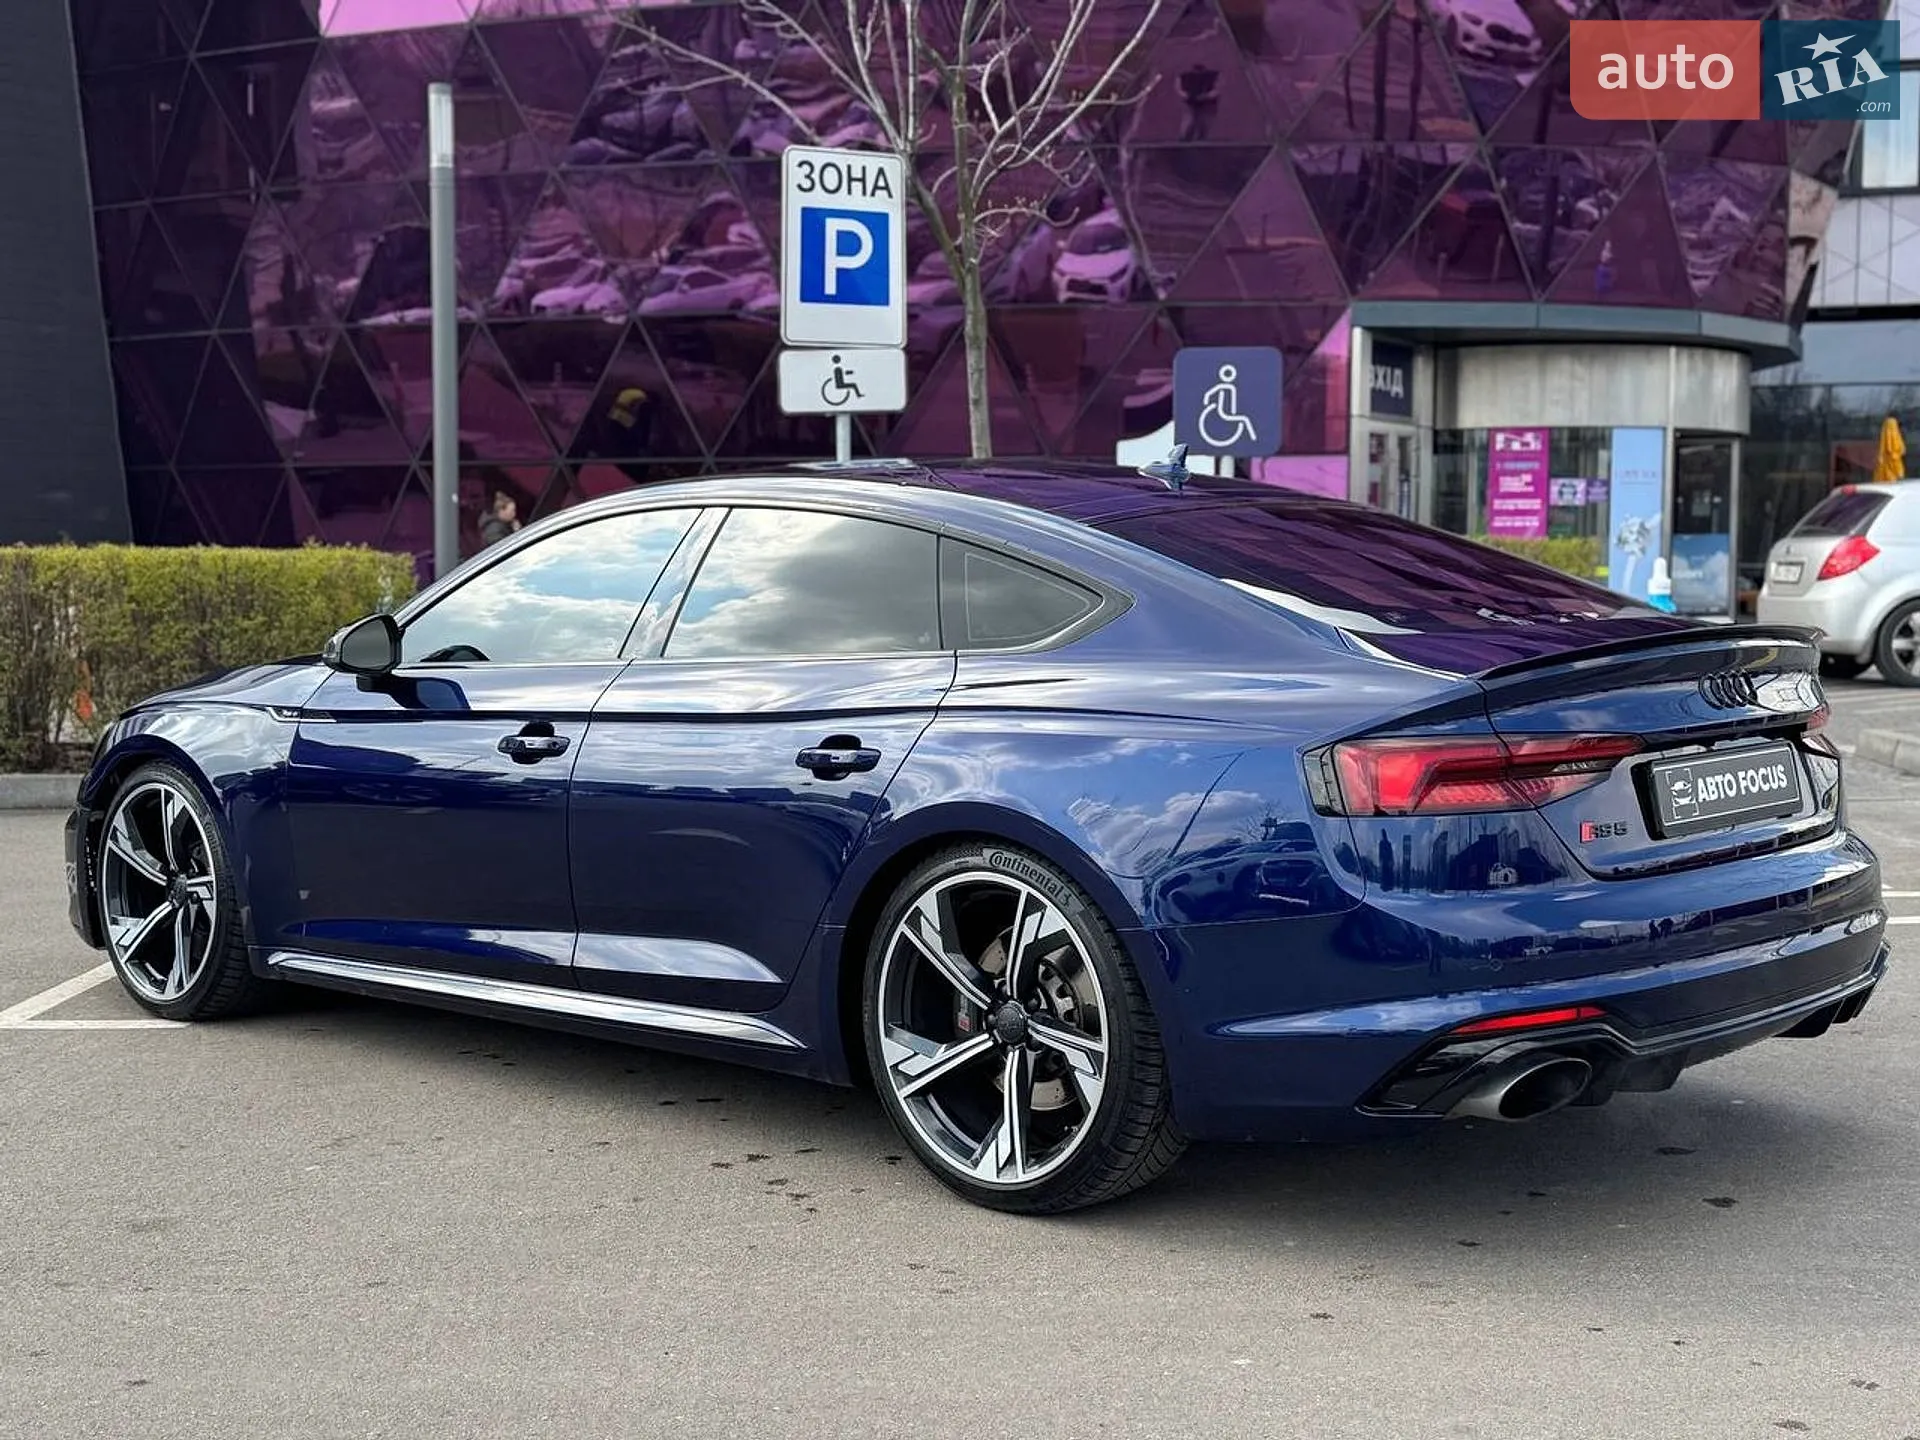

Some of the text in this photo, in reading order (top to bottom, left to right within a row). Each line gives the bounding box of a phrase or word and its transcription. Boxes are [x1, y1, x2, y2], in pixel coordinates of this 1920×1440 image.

[796, 160, 893, 199] ЗОНА
[824, 217, 874, 296] P
[1737, 764, 1788, 795] FOCUS
[989, 851, 1064, 898] Continental
